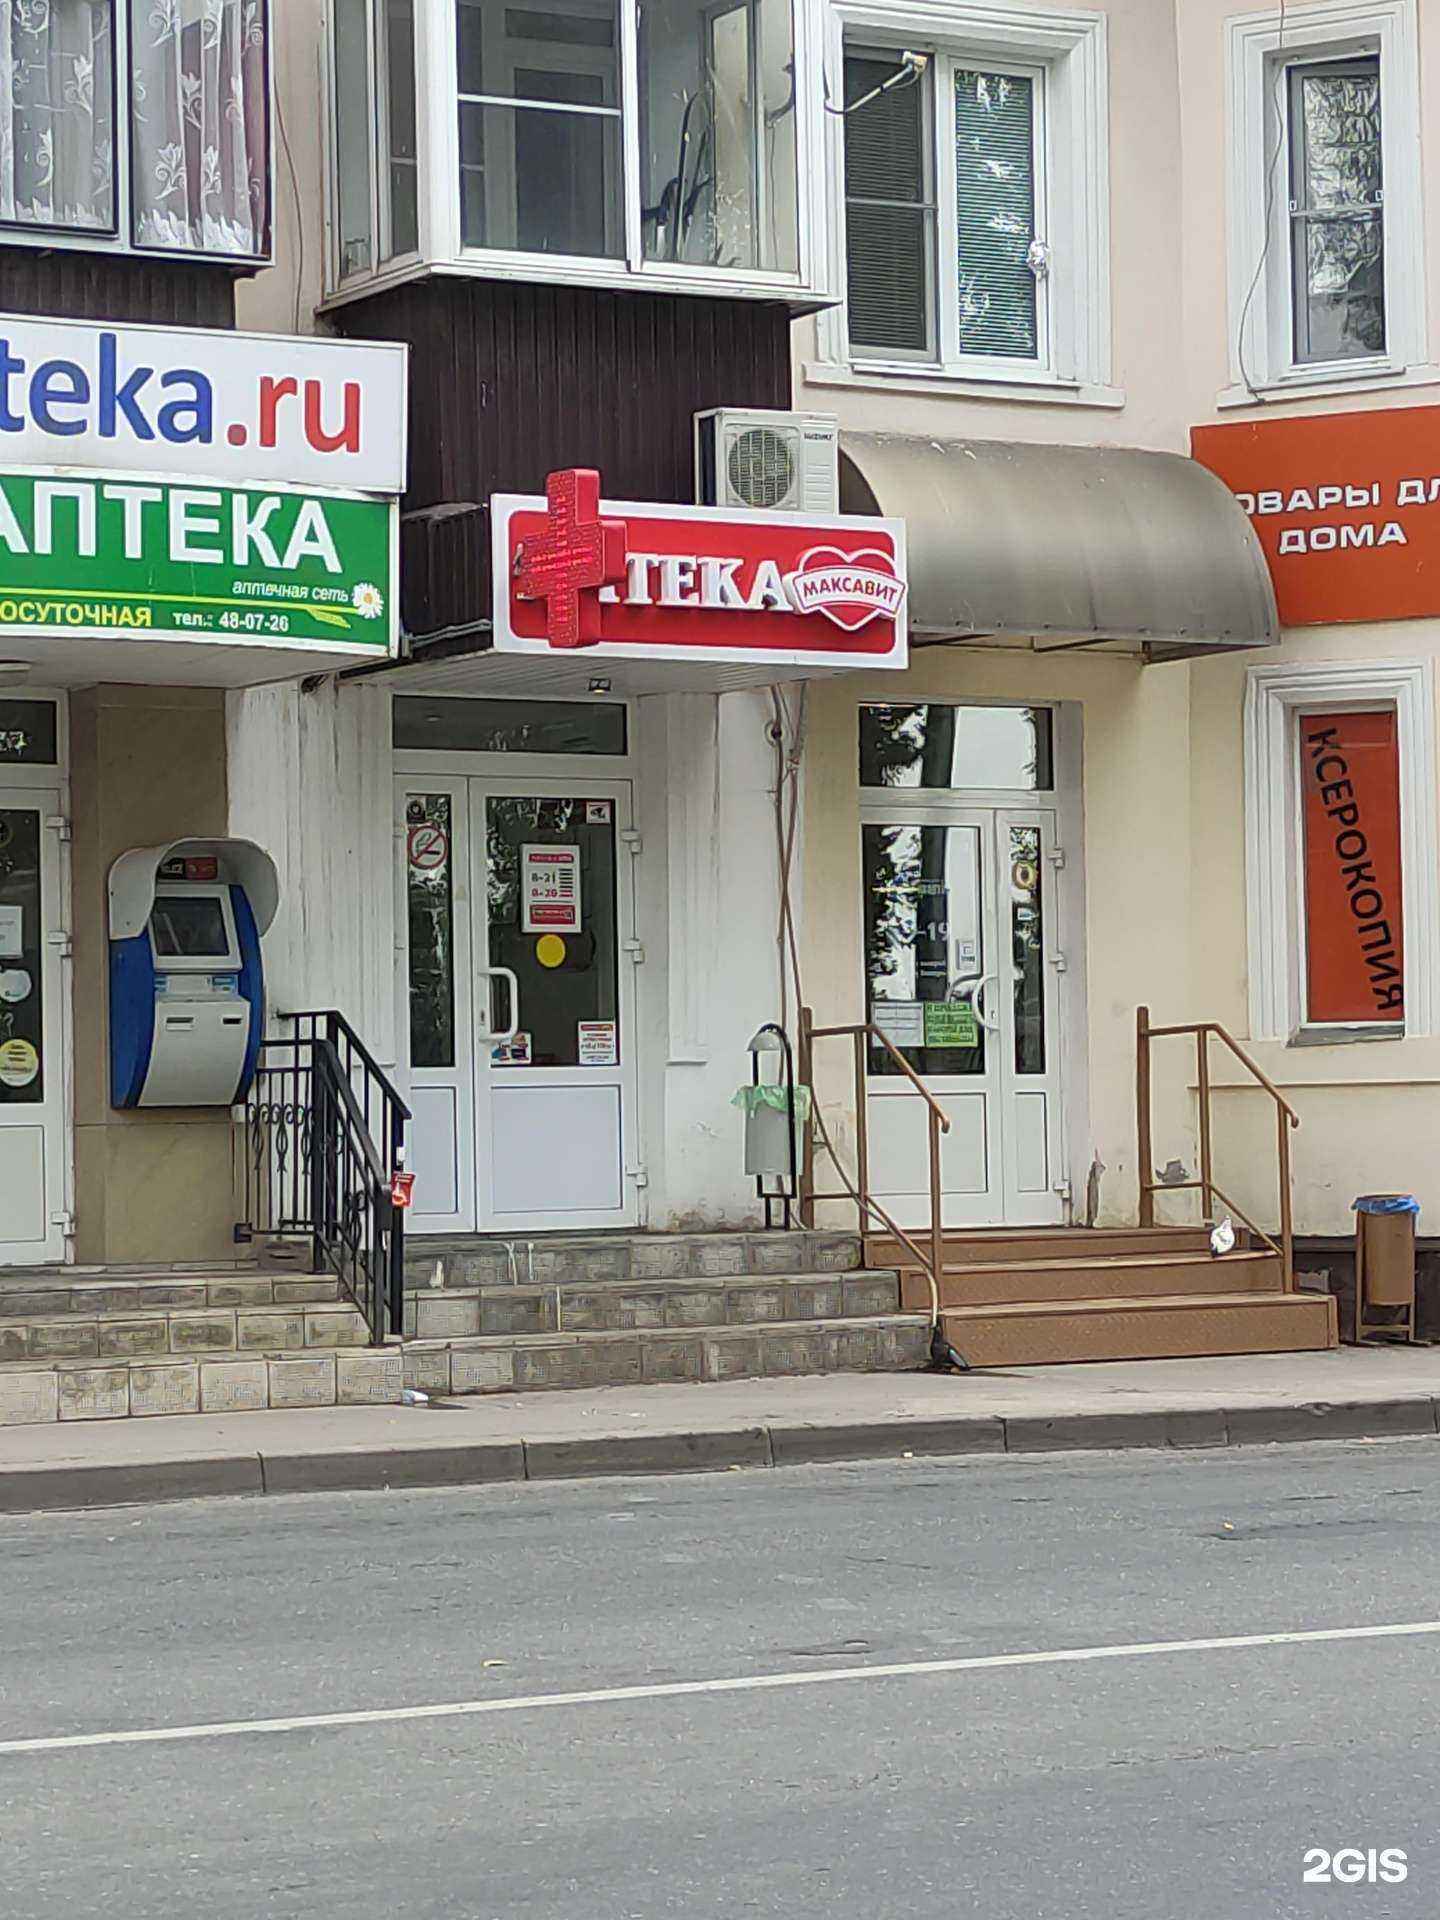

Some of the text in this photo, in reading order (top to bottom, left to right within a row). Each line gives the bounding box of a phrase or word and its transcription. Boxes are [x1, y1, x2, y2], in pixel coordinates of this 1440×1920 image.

[0, 333, 361, 453] teka.ru
[1235, 483, 1380, 515] ОВАРЫ
[1279, 522, 1408, 554] ДОМА
[232, 581, 349, 602] аптечная сеть
[516, 551, 795, 611] ТЕКА
[803, 577, 897, 603] МАКСАВИТ
[0, 600, 152, 627] ОСУТОЧНАЯ
[1308, 728, 1404, 1010] КСЕРОКОПИЯ
